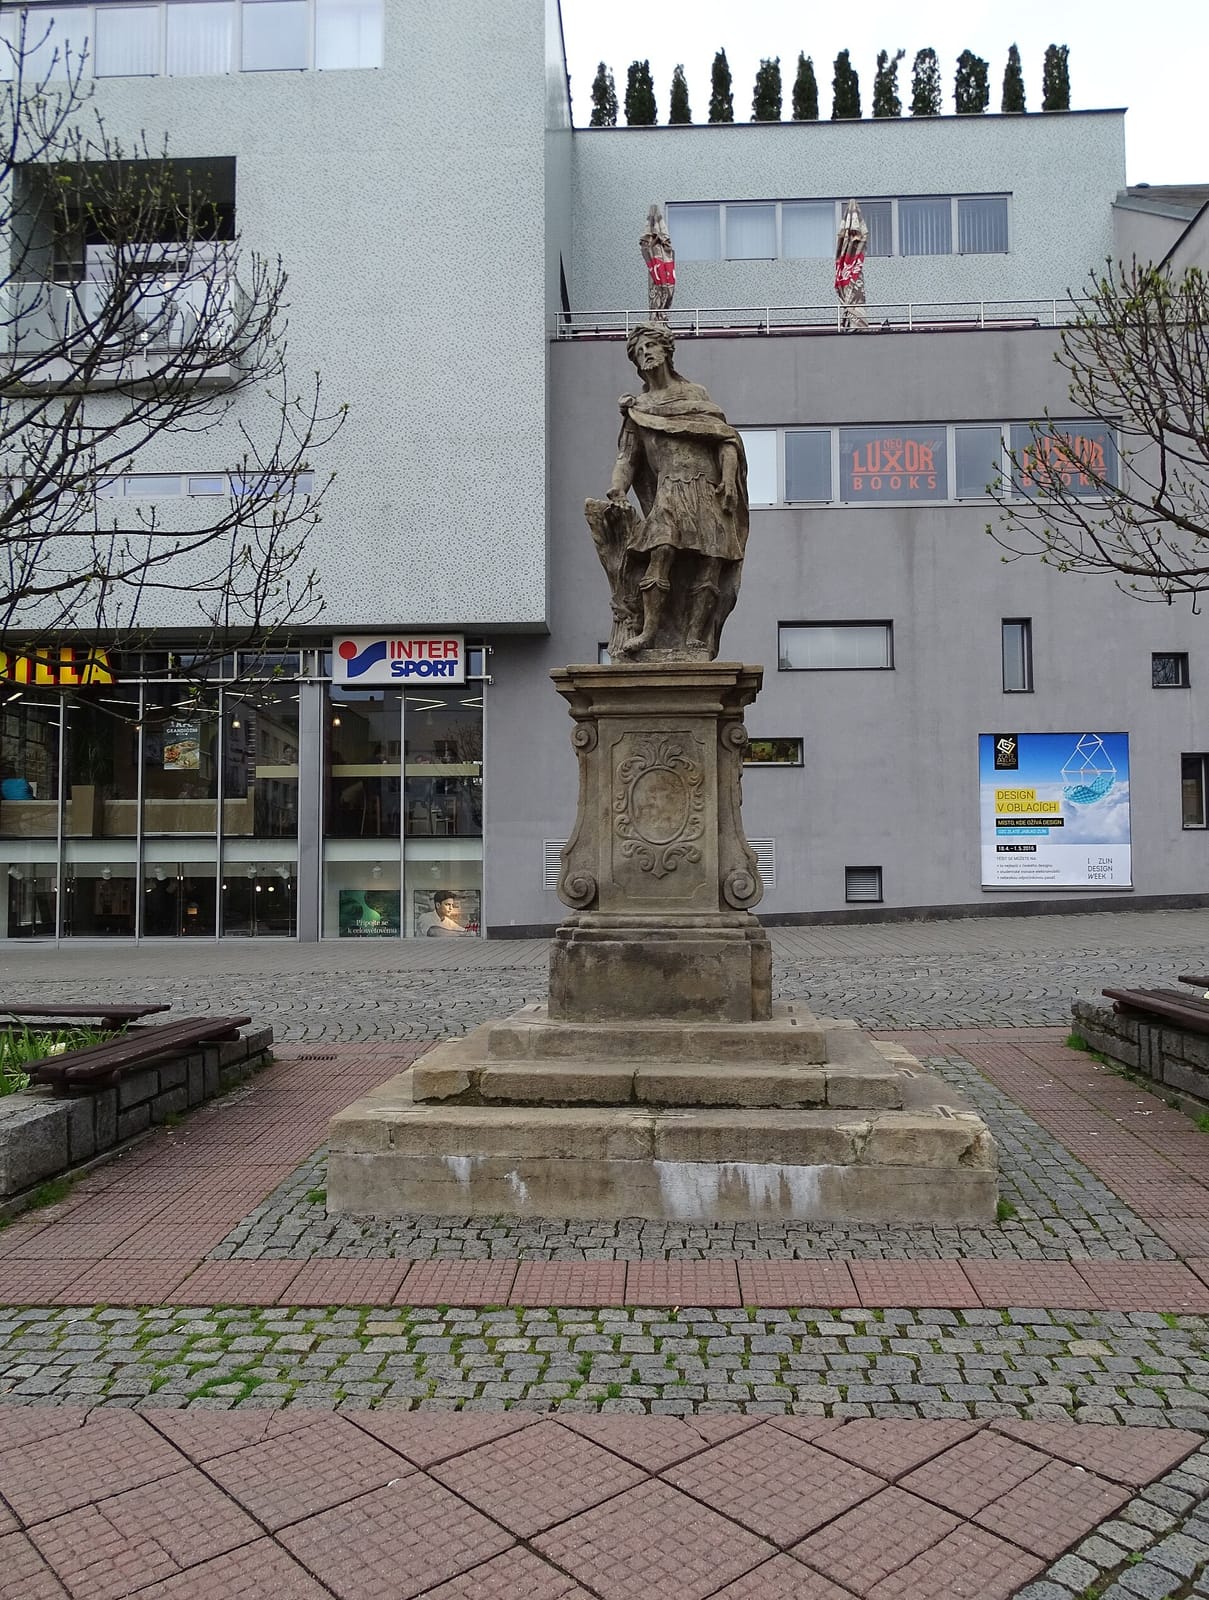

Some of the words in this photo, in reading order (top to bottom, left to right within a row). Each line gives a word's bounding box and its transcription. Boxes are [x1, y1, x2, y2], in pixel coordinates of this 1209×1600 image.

[883, 439, 902, 449] NEO
[852, 439, 935, 473] LUXOR
[853, 475, 936, 490] BOOKS
[391, 640, 458, 659] INTER
[391, 659, 458, 677] SPORT
[997, 790, 1034, 800] DESIGN
[997, 803, 1004, 812] V
[1006, 801, 1057, 812] OBLACÍCH
